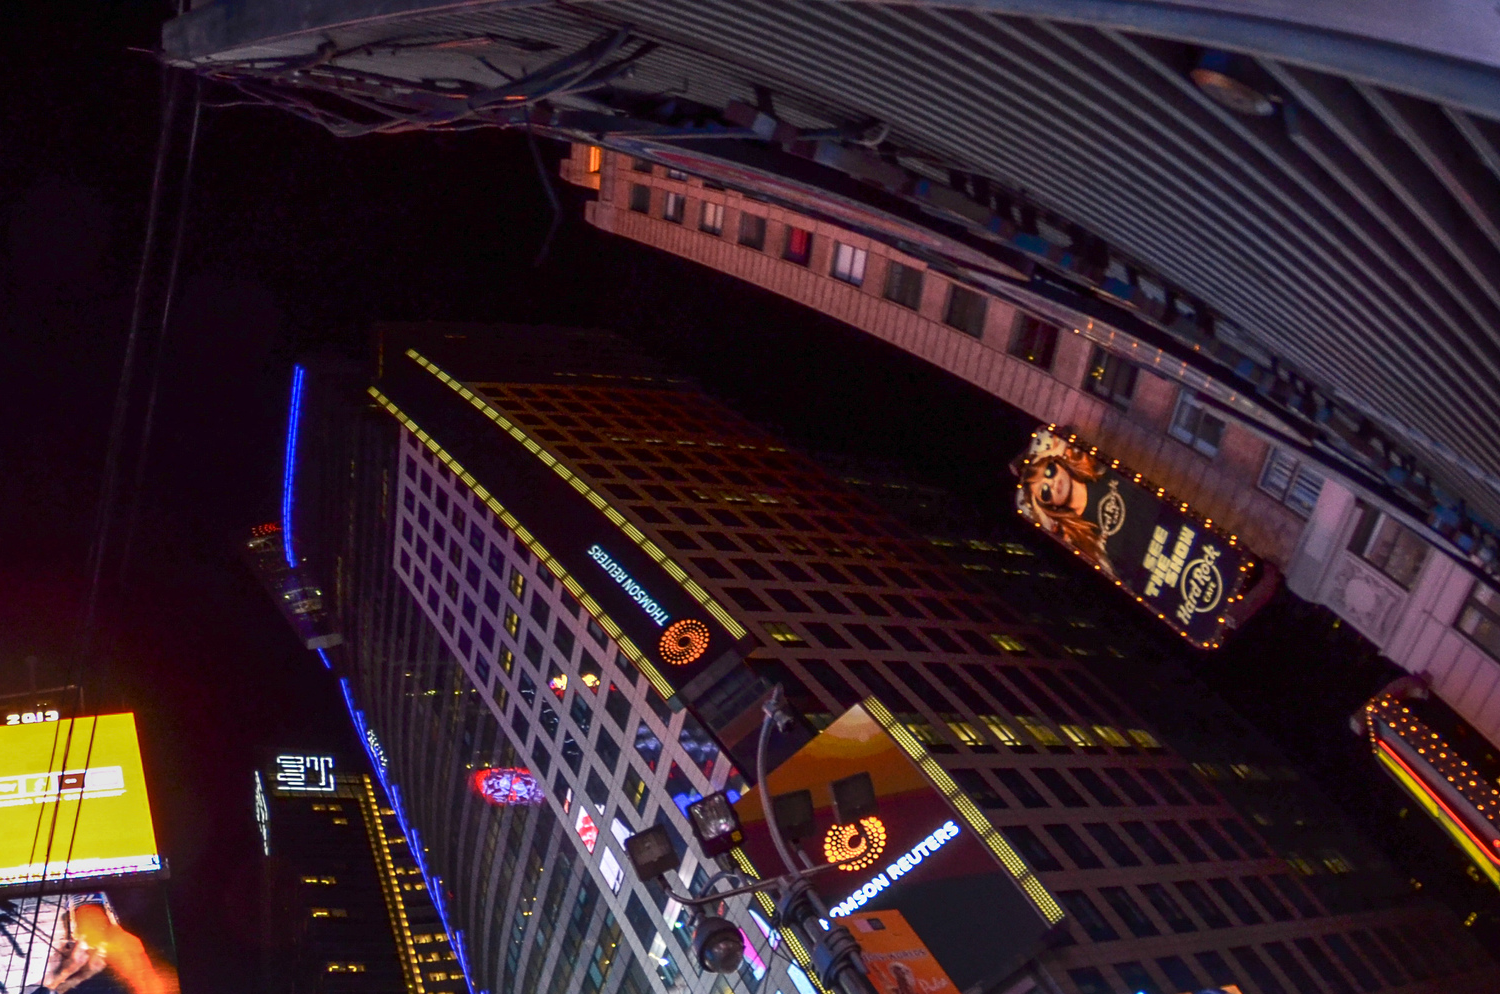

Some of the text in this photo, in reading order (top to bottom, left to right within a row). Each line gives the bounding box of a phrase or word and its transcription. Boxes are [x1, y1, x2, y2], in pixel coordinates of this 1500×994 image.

[1143, 525, 1169, 571] SEE
[1144, 553, 1172, 597] THE
[1164, 525, 1196, 588] SHOW
[587, 544, 669, 626] THOMSON REUTERS
[1176, 544, 1221, 625] Hard Rock
[6, 710, 59, 726] 2013
[818, 820, 960, 930] OMSON REUTERS
